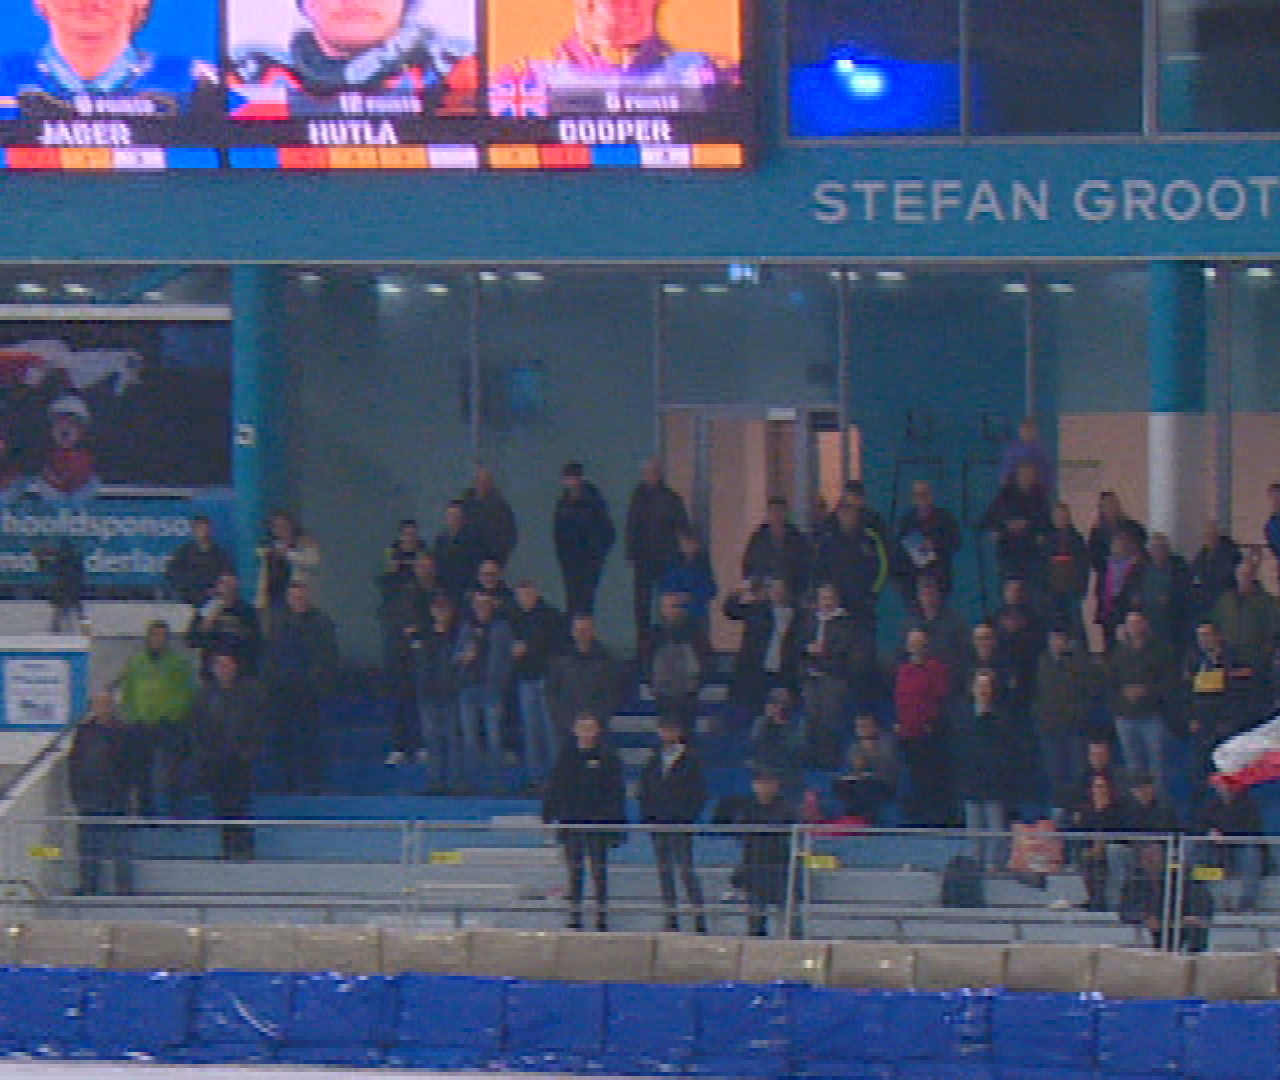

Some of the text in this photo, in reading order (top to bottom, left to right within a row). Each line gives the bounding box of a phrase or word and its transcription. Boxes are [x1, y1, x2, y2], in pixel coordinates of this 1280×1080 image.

[309, 120, 398, 145] HUTLA
[811, 179, 1050, 225] STEFAN
[1, 508, 192, 541] hoofdsponso
